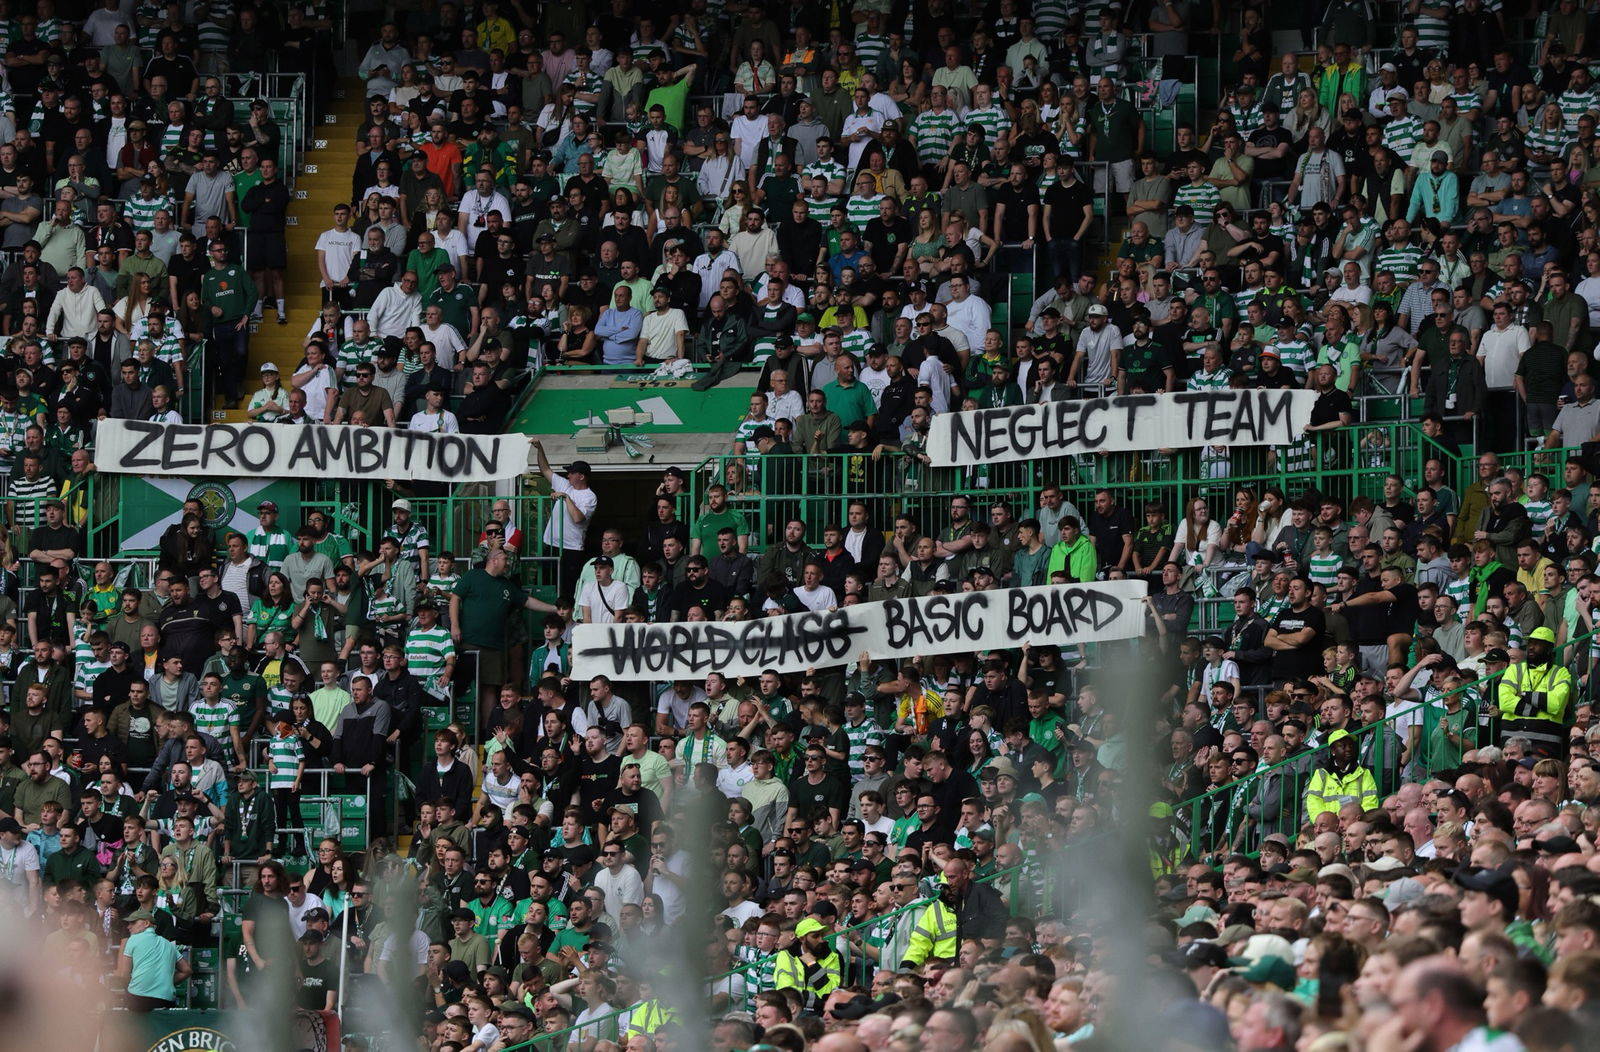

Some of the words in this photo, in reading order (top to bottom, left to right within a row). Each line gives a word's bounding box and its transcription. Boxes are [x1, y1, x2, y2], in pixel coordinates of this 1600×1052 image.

[119, 419, 277, 473] ZERO
[288, 425, 501, 477] AMBITION
[950, 395, 1156, 463] NEGLECT
[1173, 389, 1294, 445] TEAM
[883, 592, 990, 650] BASIC
[1006, 587, 1124, 641] BOARD
